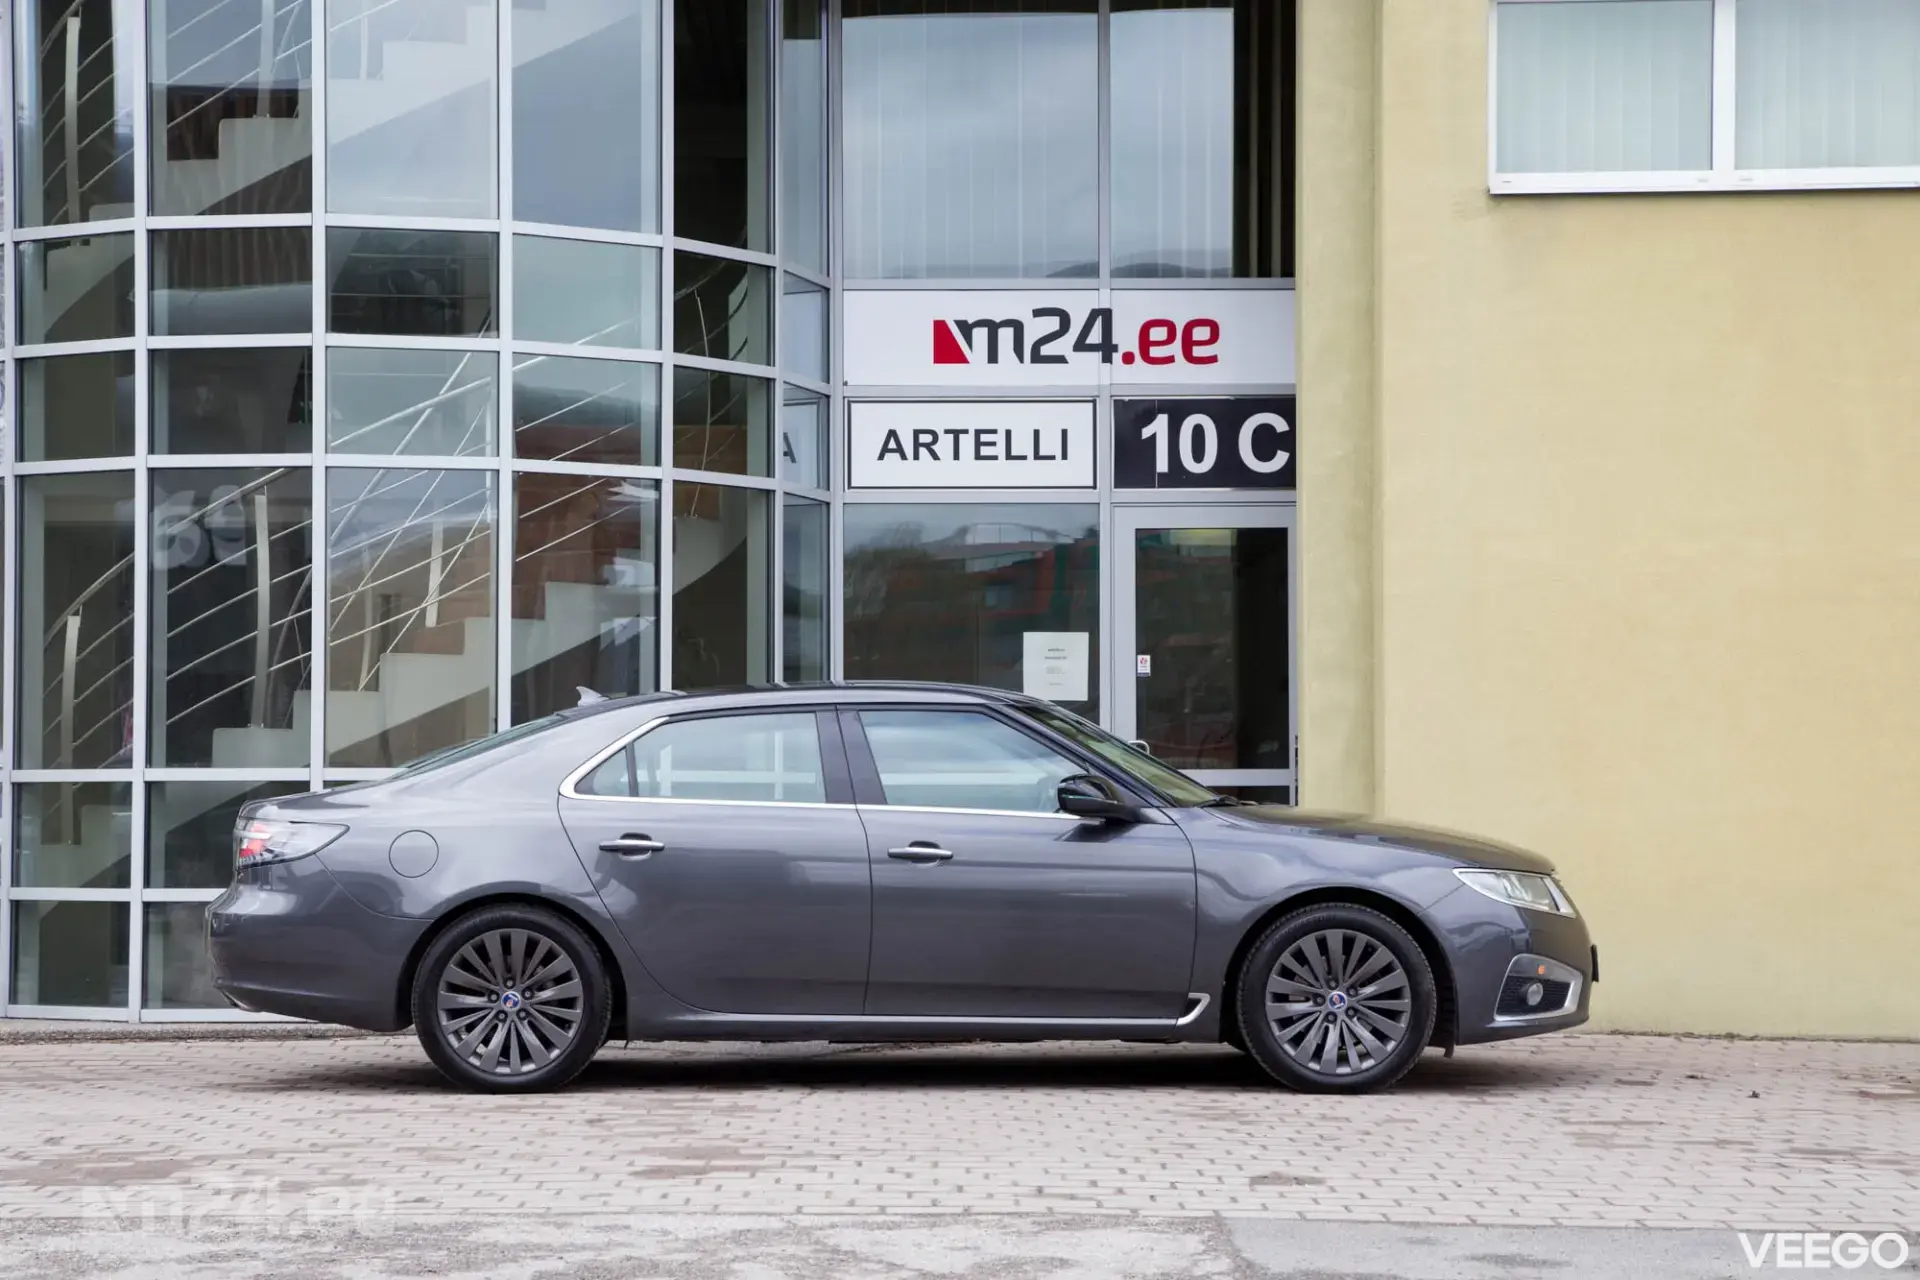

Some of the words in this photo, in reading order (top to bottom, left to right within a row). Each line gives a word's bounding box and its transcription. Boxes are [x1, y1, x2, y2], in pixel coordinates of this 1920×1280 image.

[952, 306, 1220, 366] m24.ee
[876, 428, 1069, 461] ARTELLI
[1140, 412, 1219, 474] 10
[1237, 411, 1291, 474] C
